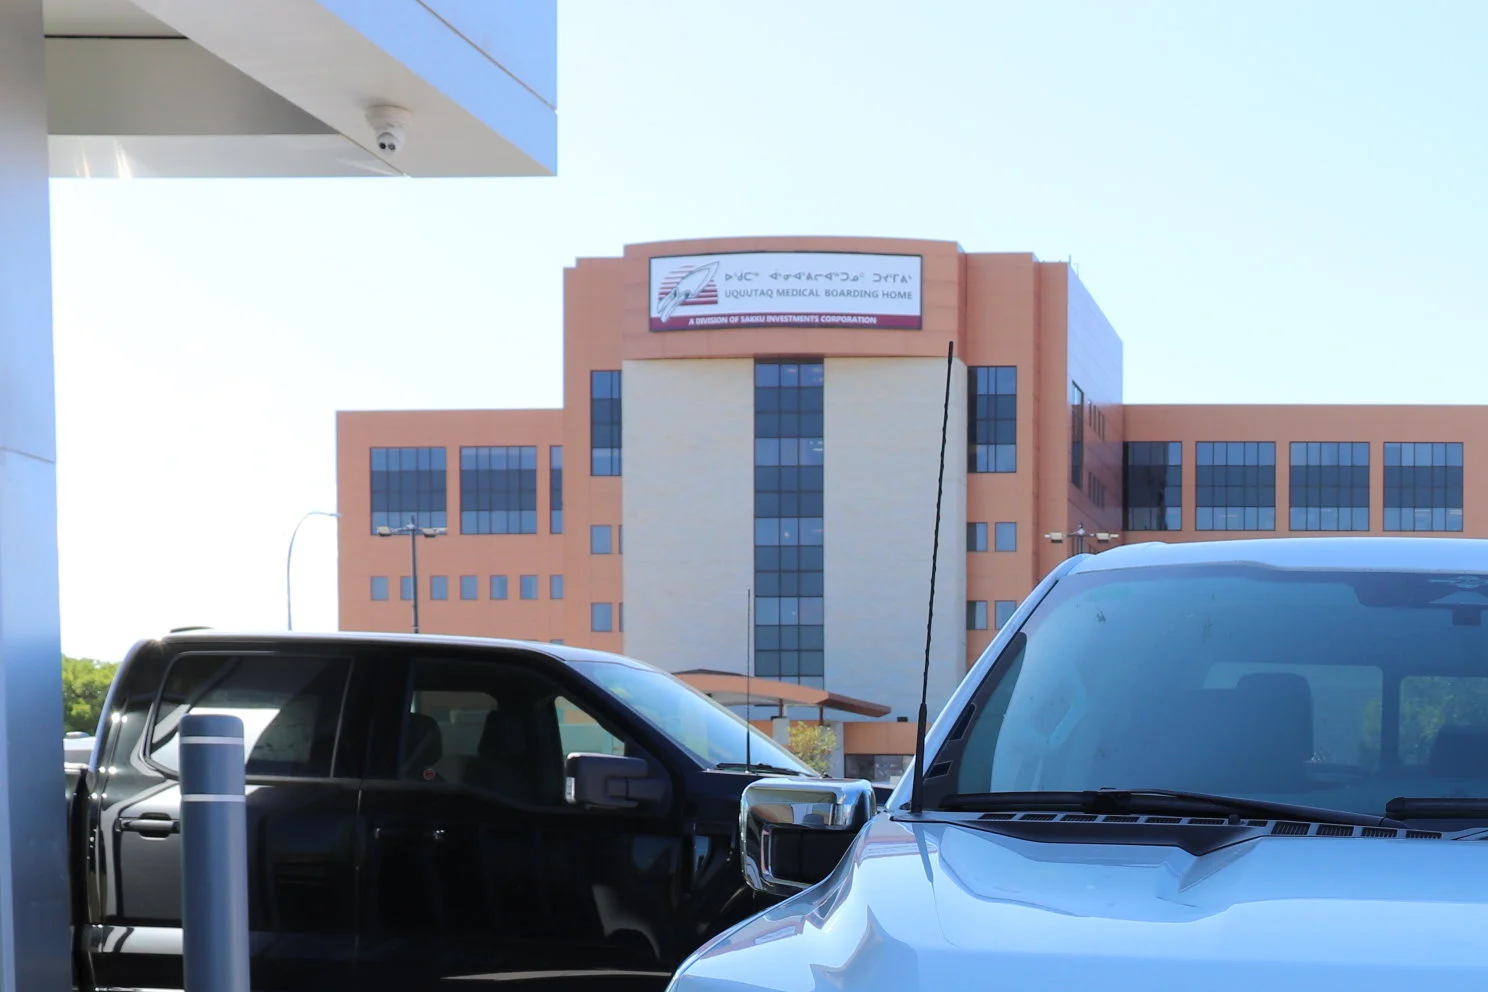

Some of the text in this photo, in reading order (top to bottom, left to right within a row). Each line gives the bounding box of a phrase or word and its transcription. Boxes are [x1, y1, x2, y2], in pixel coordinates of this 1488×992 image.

[725, 288, 913, 300] UQUUTAQ MEDICAL BOARDING HOME
[695, 317, 729, 325] DIVISION
[729, 316, 739, 324] OF
[766, 315, 820, 324] INVESTMENTS
[820, 315, 877, 325] CORPORATION
